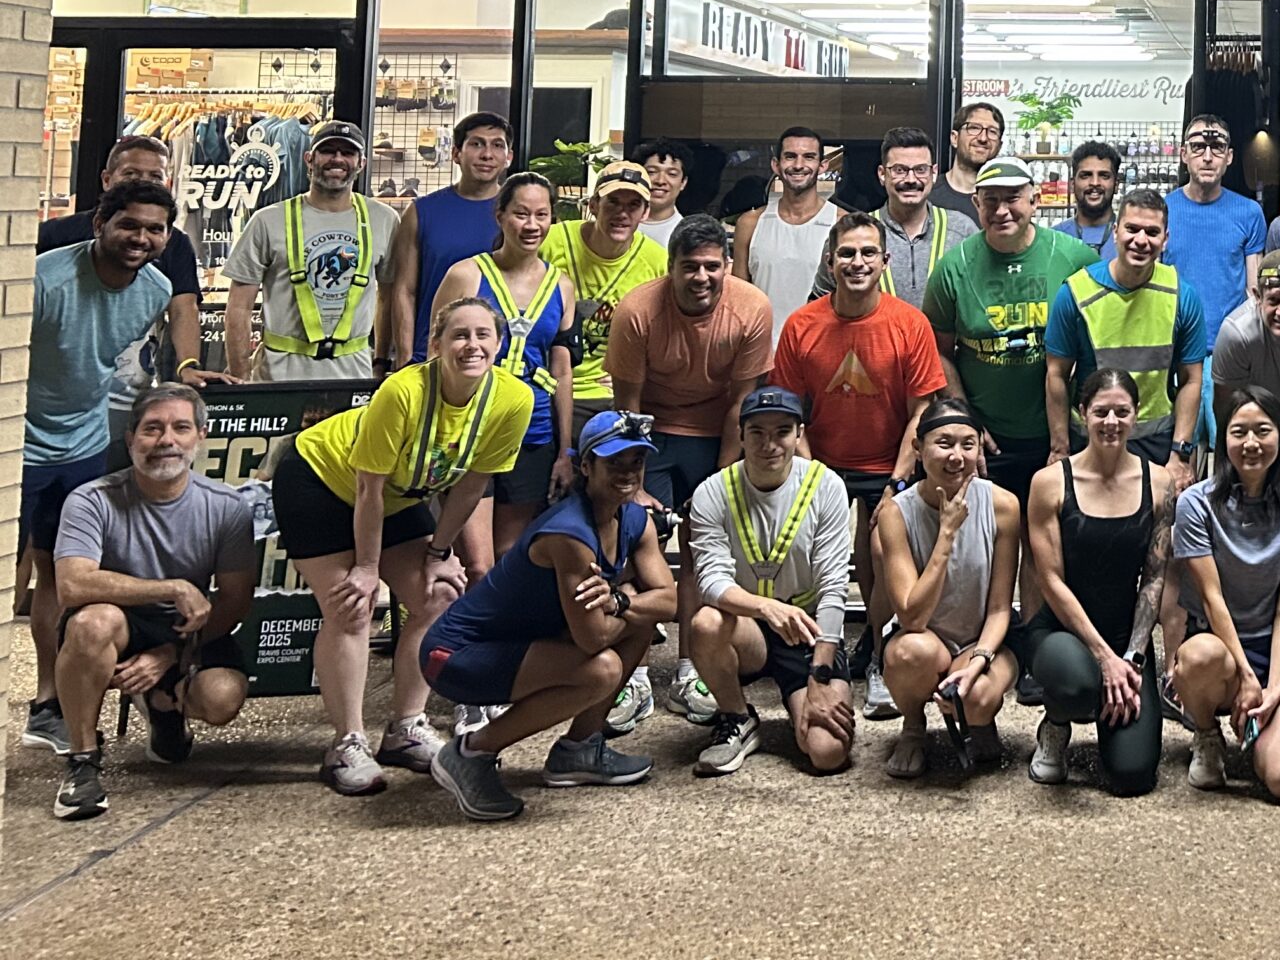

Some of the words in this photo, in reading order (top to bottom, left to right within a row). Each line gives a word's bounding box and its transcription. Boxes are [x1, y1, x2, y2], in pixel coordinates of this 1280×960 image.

[702, 2, 776, 62] READY
[784, 28, 808, 72] TO
[816, 40, 849, 77] RUN
[963, 80, 1005, 92] STROOM
[1034, 76, 1149, 98] Friendliest
[178, 164, 242, 179] READY
[245, 164, 266, 179] to
[179, 181, 263, 210] RUN
[311, 233, 360, 247] COWTOW
[986, 301, 1049, 331] RUN
[219, 417, 247, 433] THE
[250, 416, 288, 432] HILL?
[258, 633, 291, 647] 2025
[256, 656, 275, 664] EXPO
[276, 655, 302, 663] CENTER
[258, 649, 280, 657] TRAVIS
[281, 647, 310, 656] COUNTY
